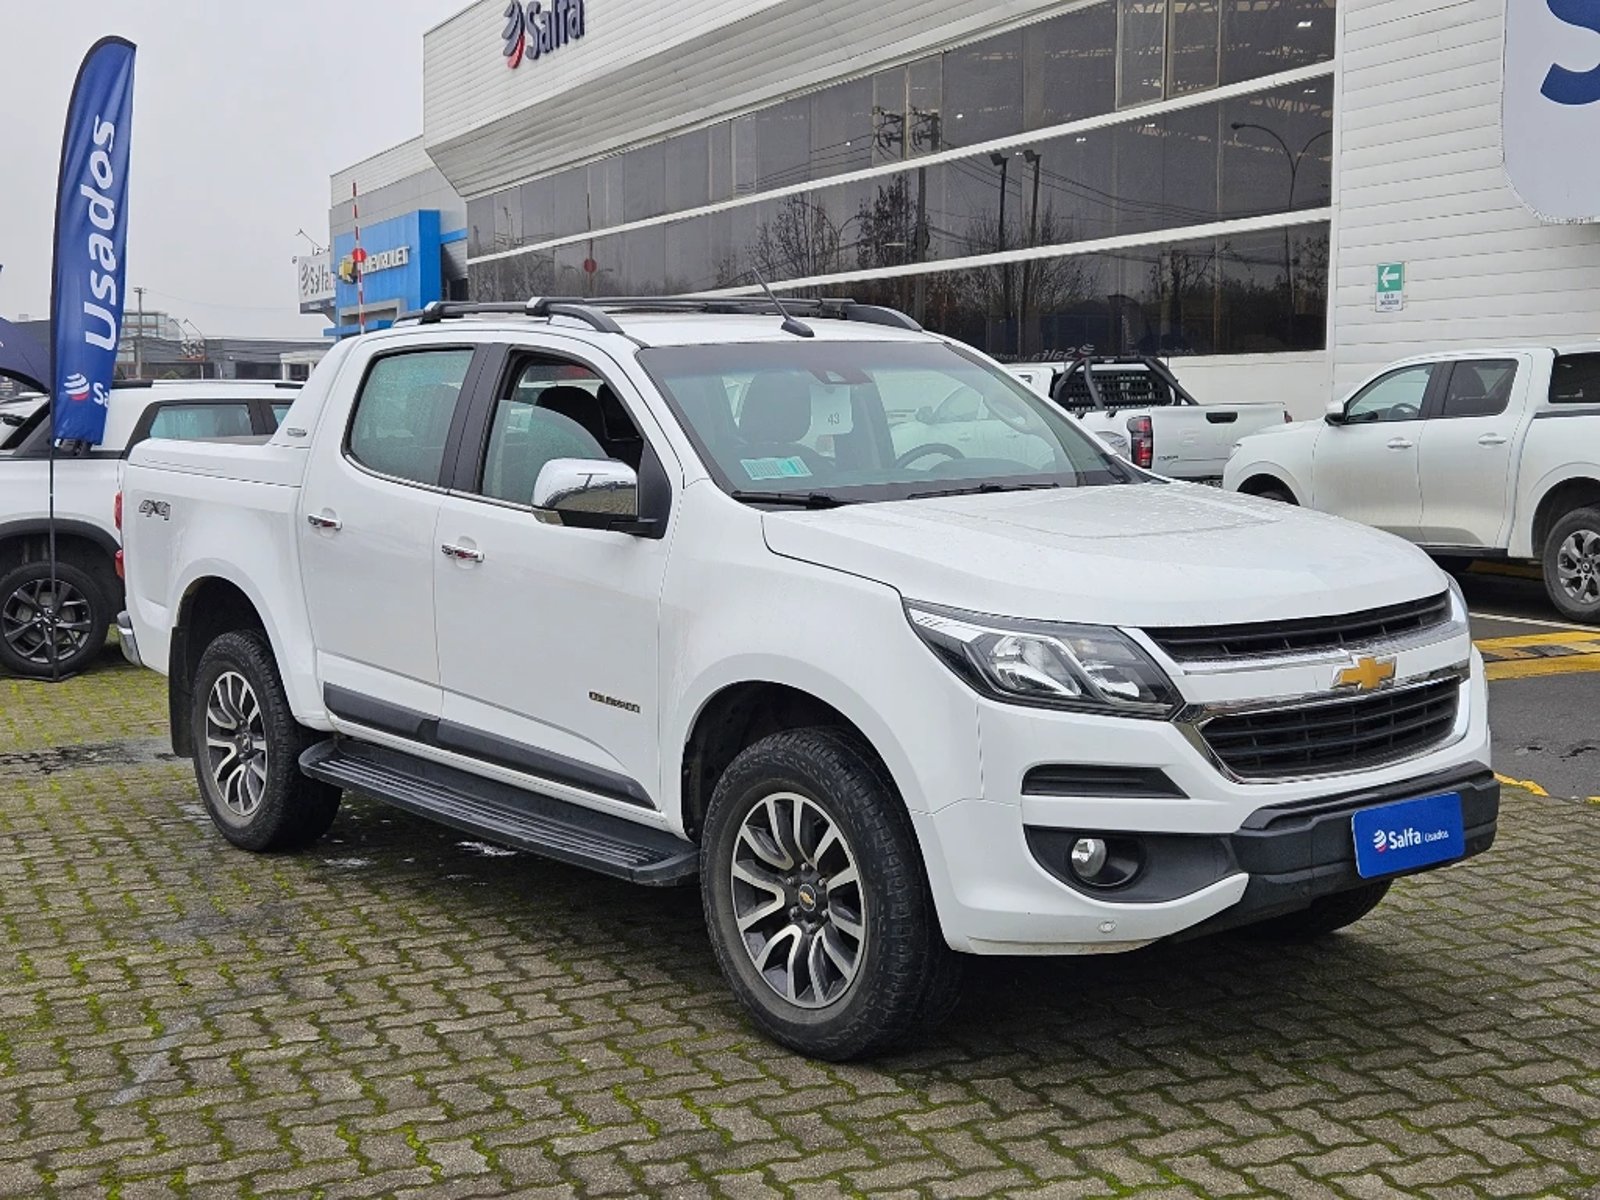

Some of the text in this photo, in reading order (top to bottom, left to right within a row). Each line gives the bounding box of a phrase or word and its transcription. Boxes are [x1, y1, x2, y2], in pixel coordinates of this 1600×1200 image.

[525, 0, 585, 60] Salfa
[79, 114, 118, 352] Usados
[827, 412, 840, 425] 43
[1388, 827, 1449, 850] Salfa Usados
